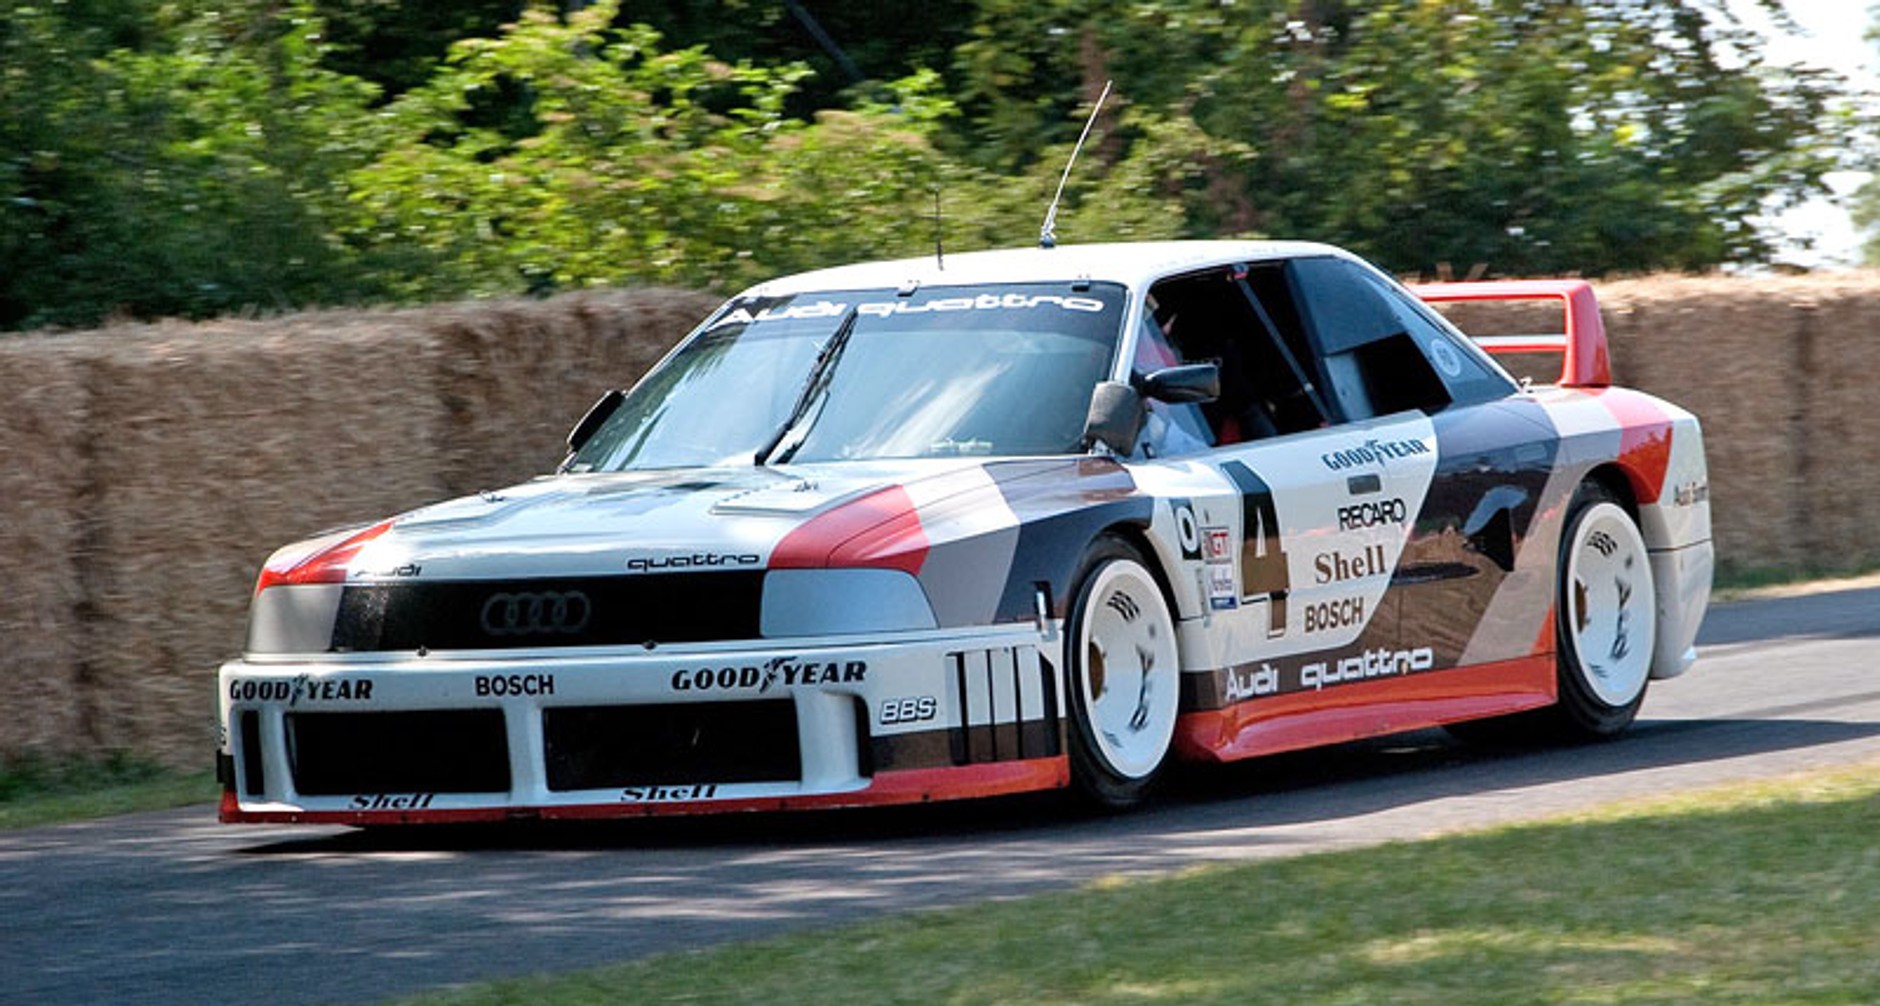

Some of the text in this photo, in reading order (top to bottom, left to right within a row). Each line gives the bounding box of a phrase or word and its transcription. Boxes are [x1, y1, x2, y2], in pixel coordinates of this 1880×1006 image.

[706, 294, 1104, 332] Audi quattro
[1338, 498, 1406, 531] RECARO
[627, 553, 760, 573] quattro
[1220, 459, 1291, 640] 4
[1314, 544, 1386, 585] Shell
[1305, 597, 1365, 633] BOSCH
[475, 674, 555, 697] BOSCH
[1225, 647, 1433, 702] Audi quattro
[880, 697, 937, 725] BBS
[348, 792, 434, 810] Shell
[619, 783, 717, 802] Shell
